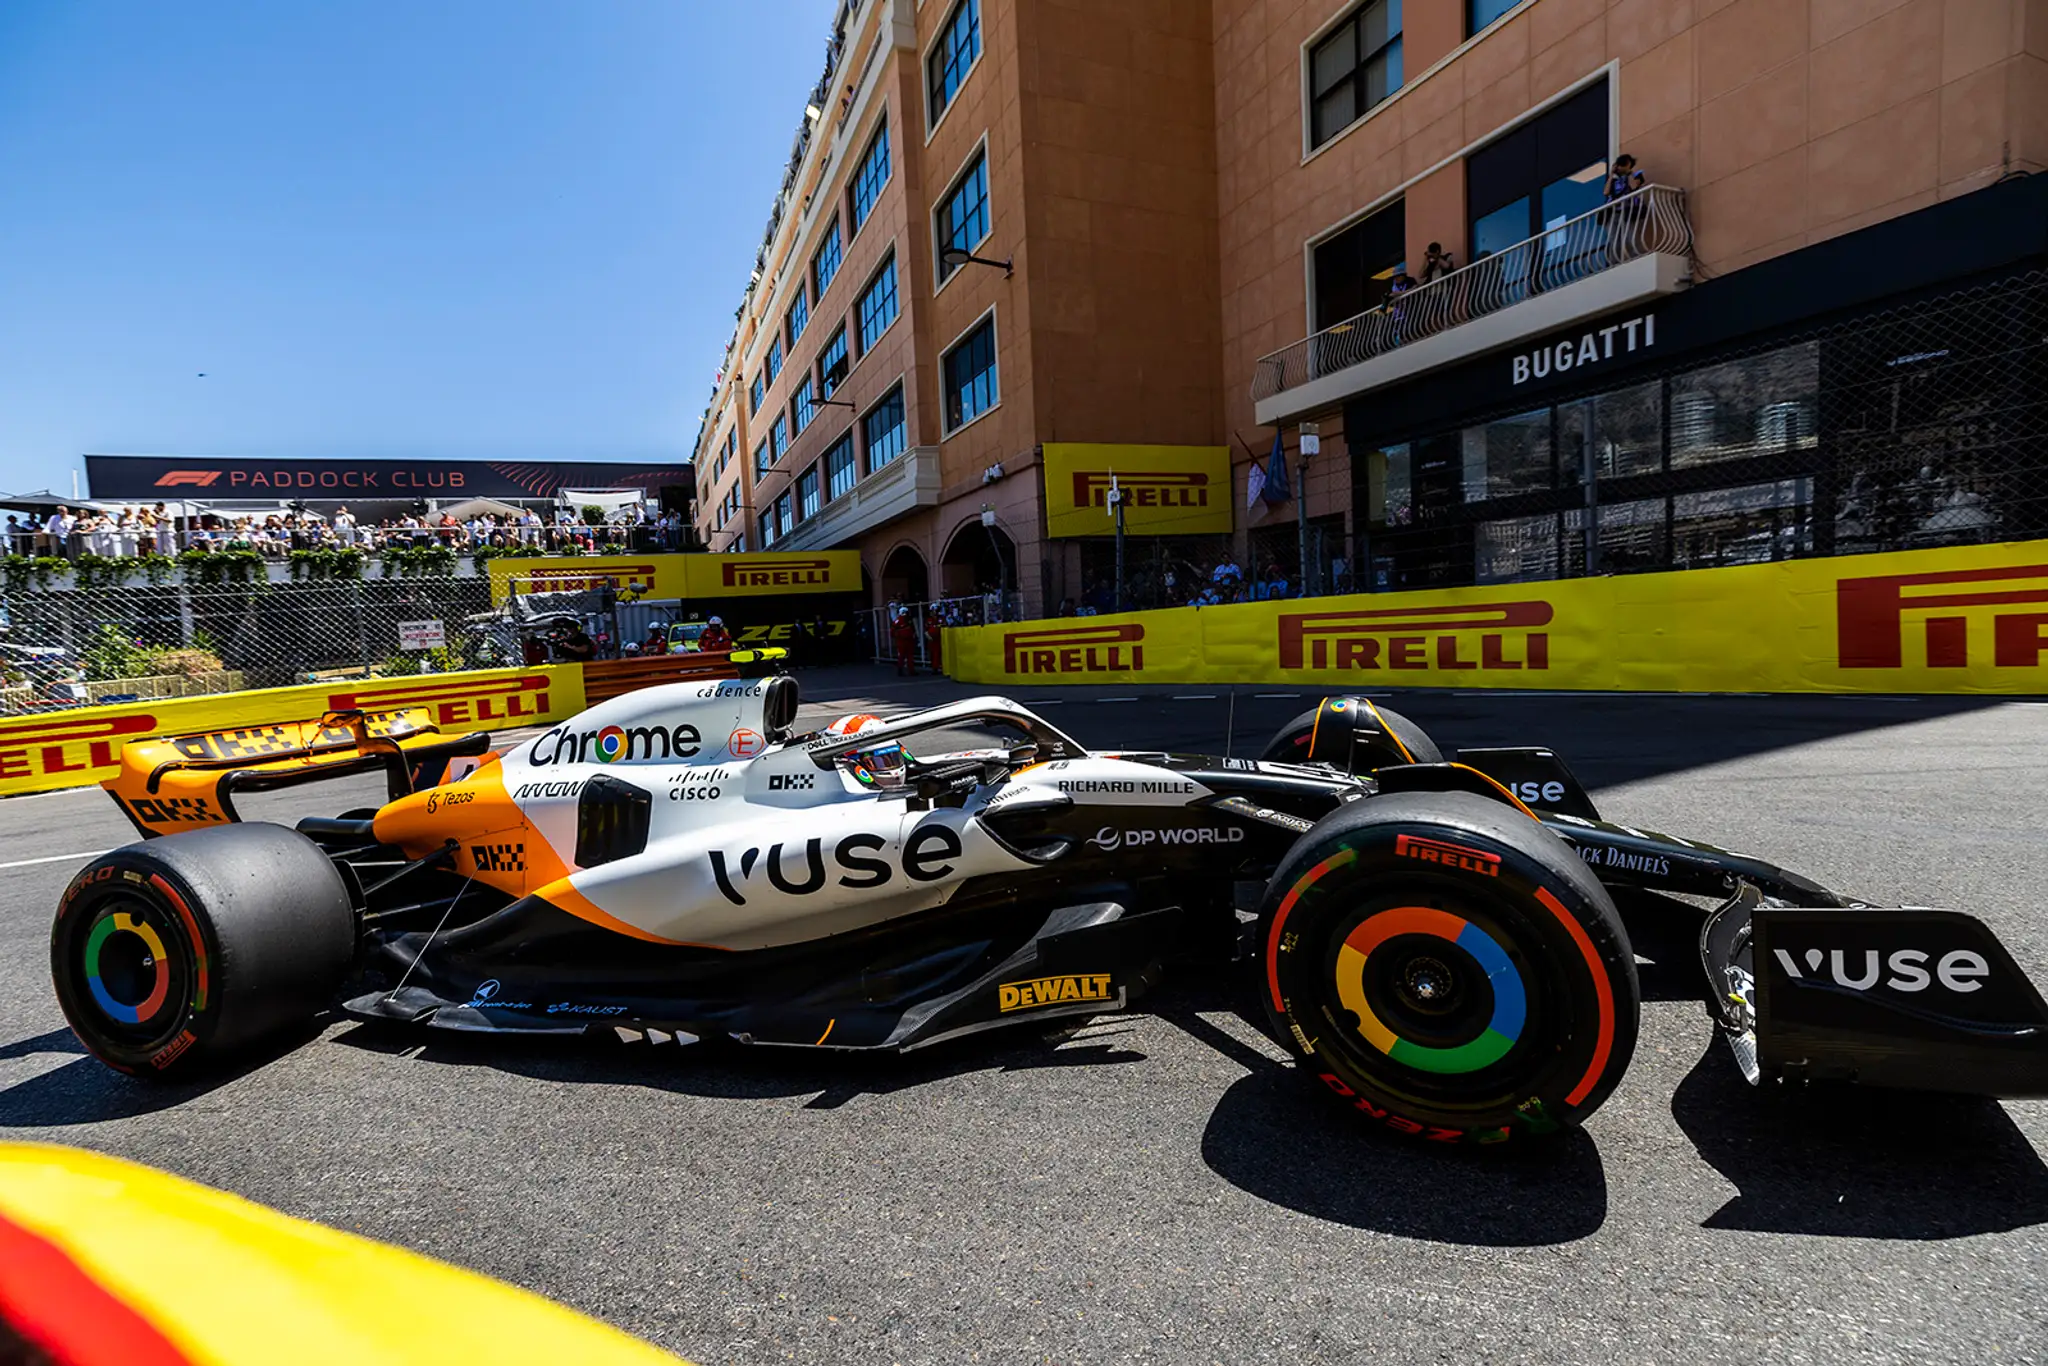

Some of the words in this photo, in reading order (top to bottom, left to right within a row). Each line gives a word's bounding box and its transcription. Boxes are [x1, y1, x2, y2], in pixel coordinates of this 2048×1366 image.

[1512, 314, 1656, 385] BUGATTI
[230, 471, 380, 488] PADDOCK
[391, 472, 466, 488] CLUB
[722, 560, 831, 587] PIRELLI
[1004, 624, 1144, 674] PIRELLI
[1278, 600, 1554, 670] PIRELLI
[328, 675, 551, 725] PELLI
[529, 723, 702, 766] Chrome
[442, 792, 476, 806] Tezos
[768, 774, 815, 790] OKX
[1058, 780, 1134, 793] RICHARD
[1141, 782, 1194, 794] MILLE
[1126, 830, 1156, 846] DP
[1159, 828, 1244, 844] WORLD
[1573, 845, 1603, 863] ACK
[1395, 834, 1502, 877] PIRELLI
[1317, 1073, 1464, 1143] ZERO
